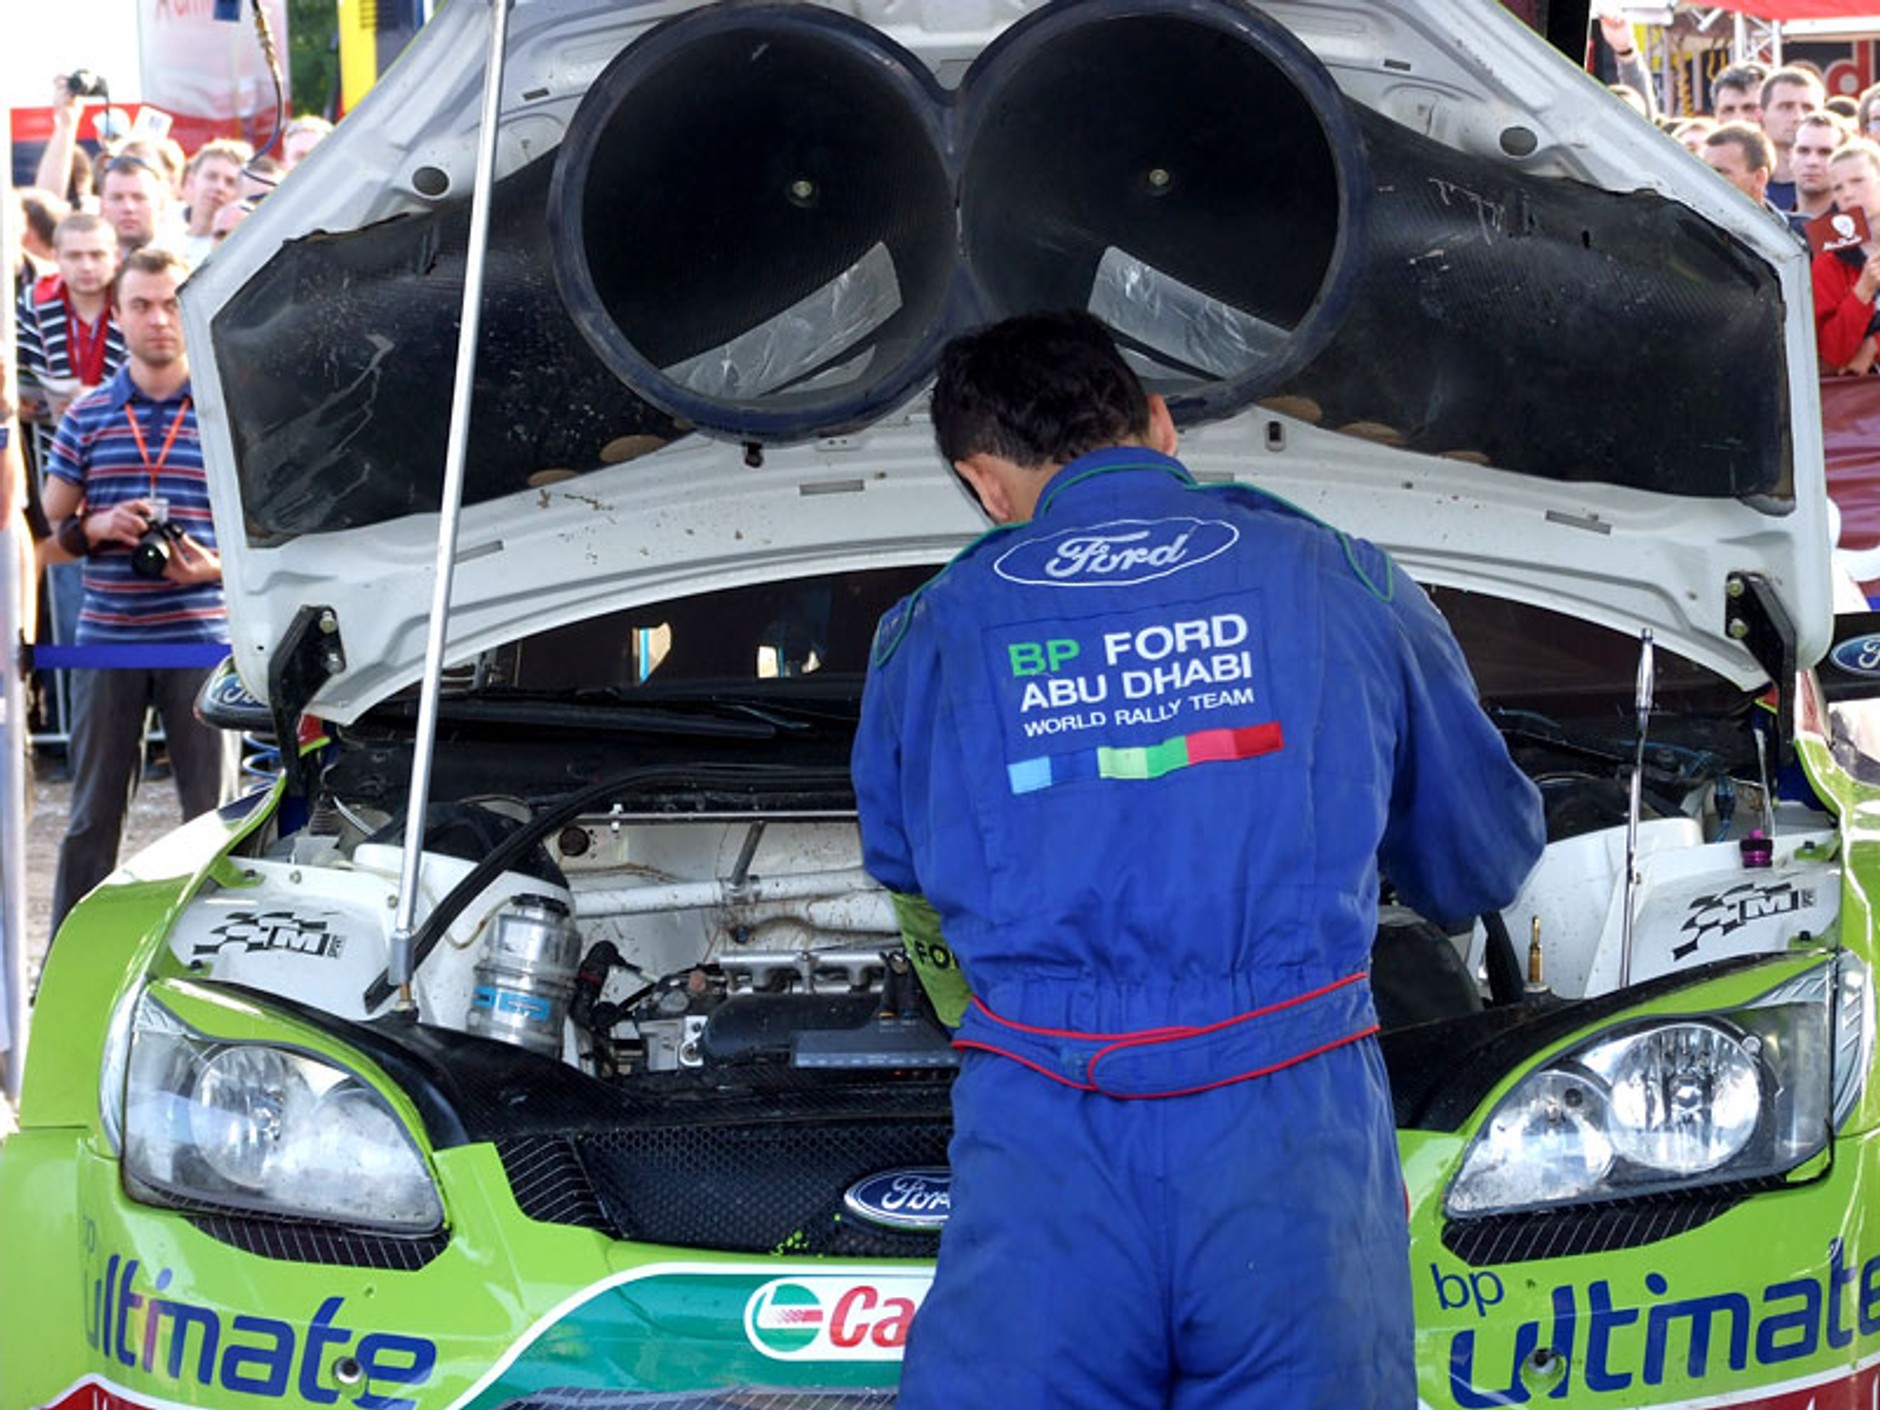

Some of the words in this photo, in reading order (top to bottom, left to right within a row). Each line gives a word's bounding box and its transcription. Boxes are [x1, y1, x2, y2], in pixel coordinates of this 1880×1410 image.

[1045, 529, 1190, 579] Ford
[1007, 638, 1081, 678] BP
[1103, 613, 1248, 667] FORD
[1020, 673, 1108, 713] ABU
[1122, 650, 1253, 700] DHABI
[1023, 710, 1107, 738] WORLD
[1114, 697, 1183, 726] RALLY
[1187, 687, 1255, 712] TEAM
[914, 940, 960, 970] FO
[1430, 1263, 1505, 1318] bp
